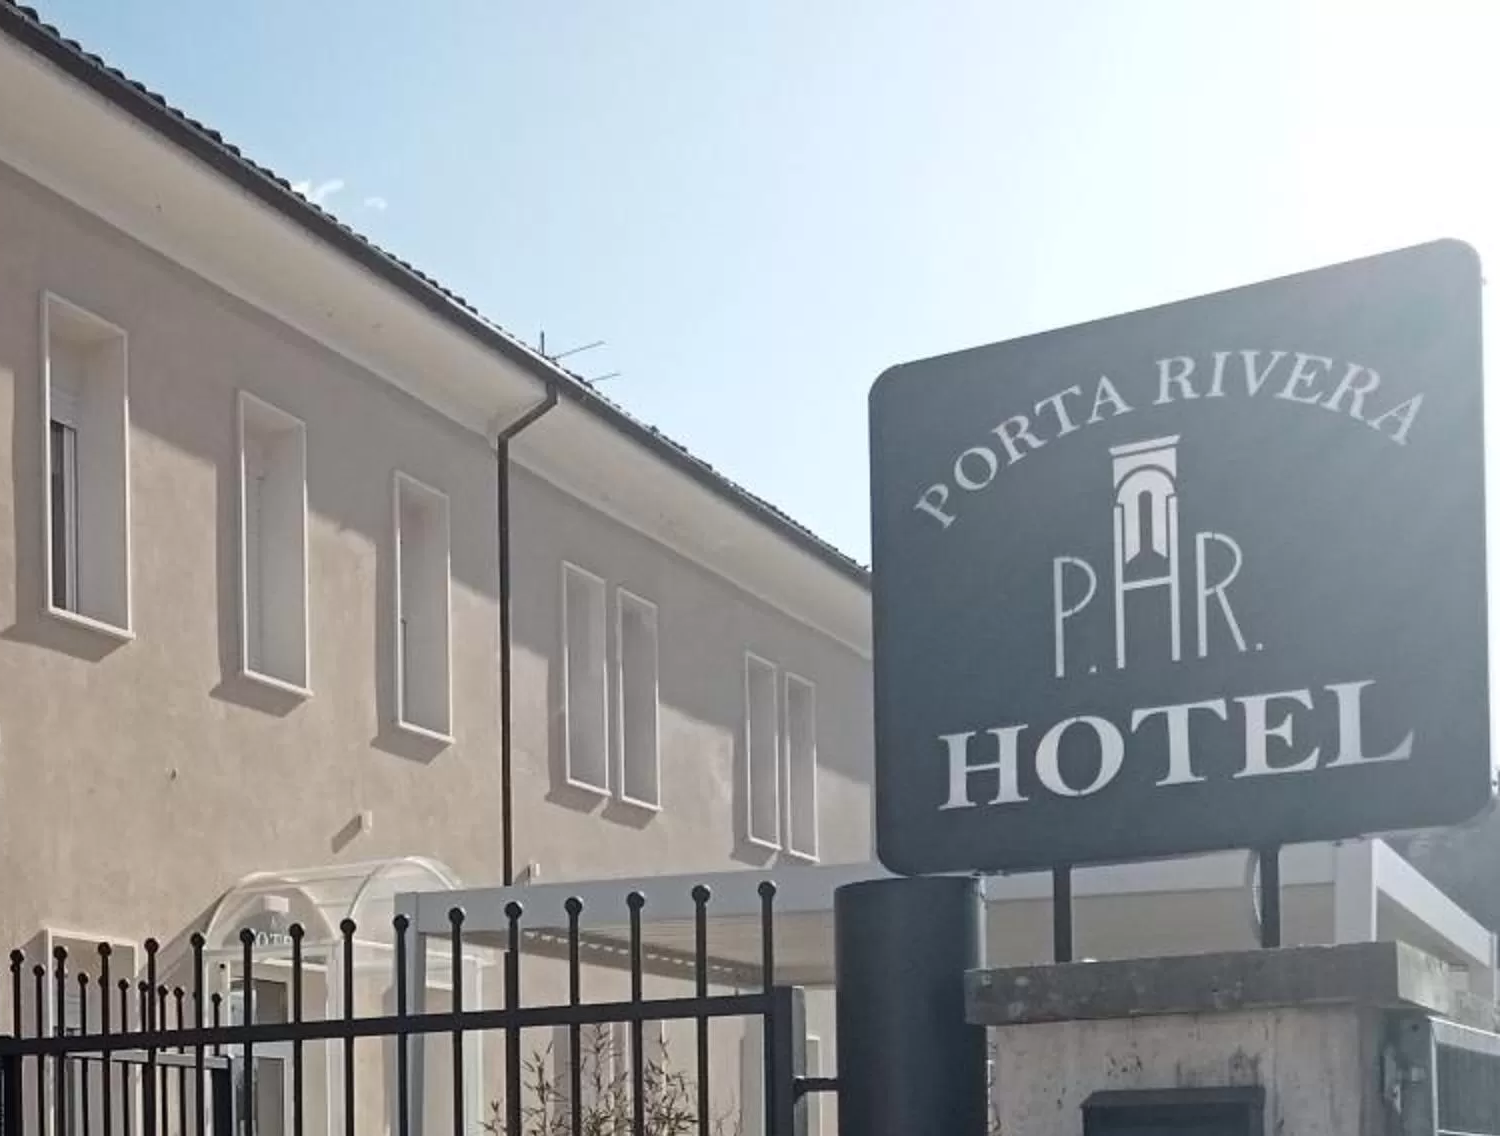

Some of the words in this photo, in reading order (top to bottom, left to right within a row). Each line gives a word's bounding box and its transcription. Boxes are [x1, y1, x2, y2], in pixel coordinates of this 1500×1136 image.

[913, 376, 1134, 528] PORTA
[1154, 350, 1424, 445] RIVERA
[938, 679, 1414, 811] HOTEL
